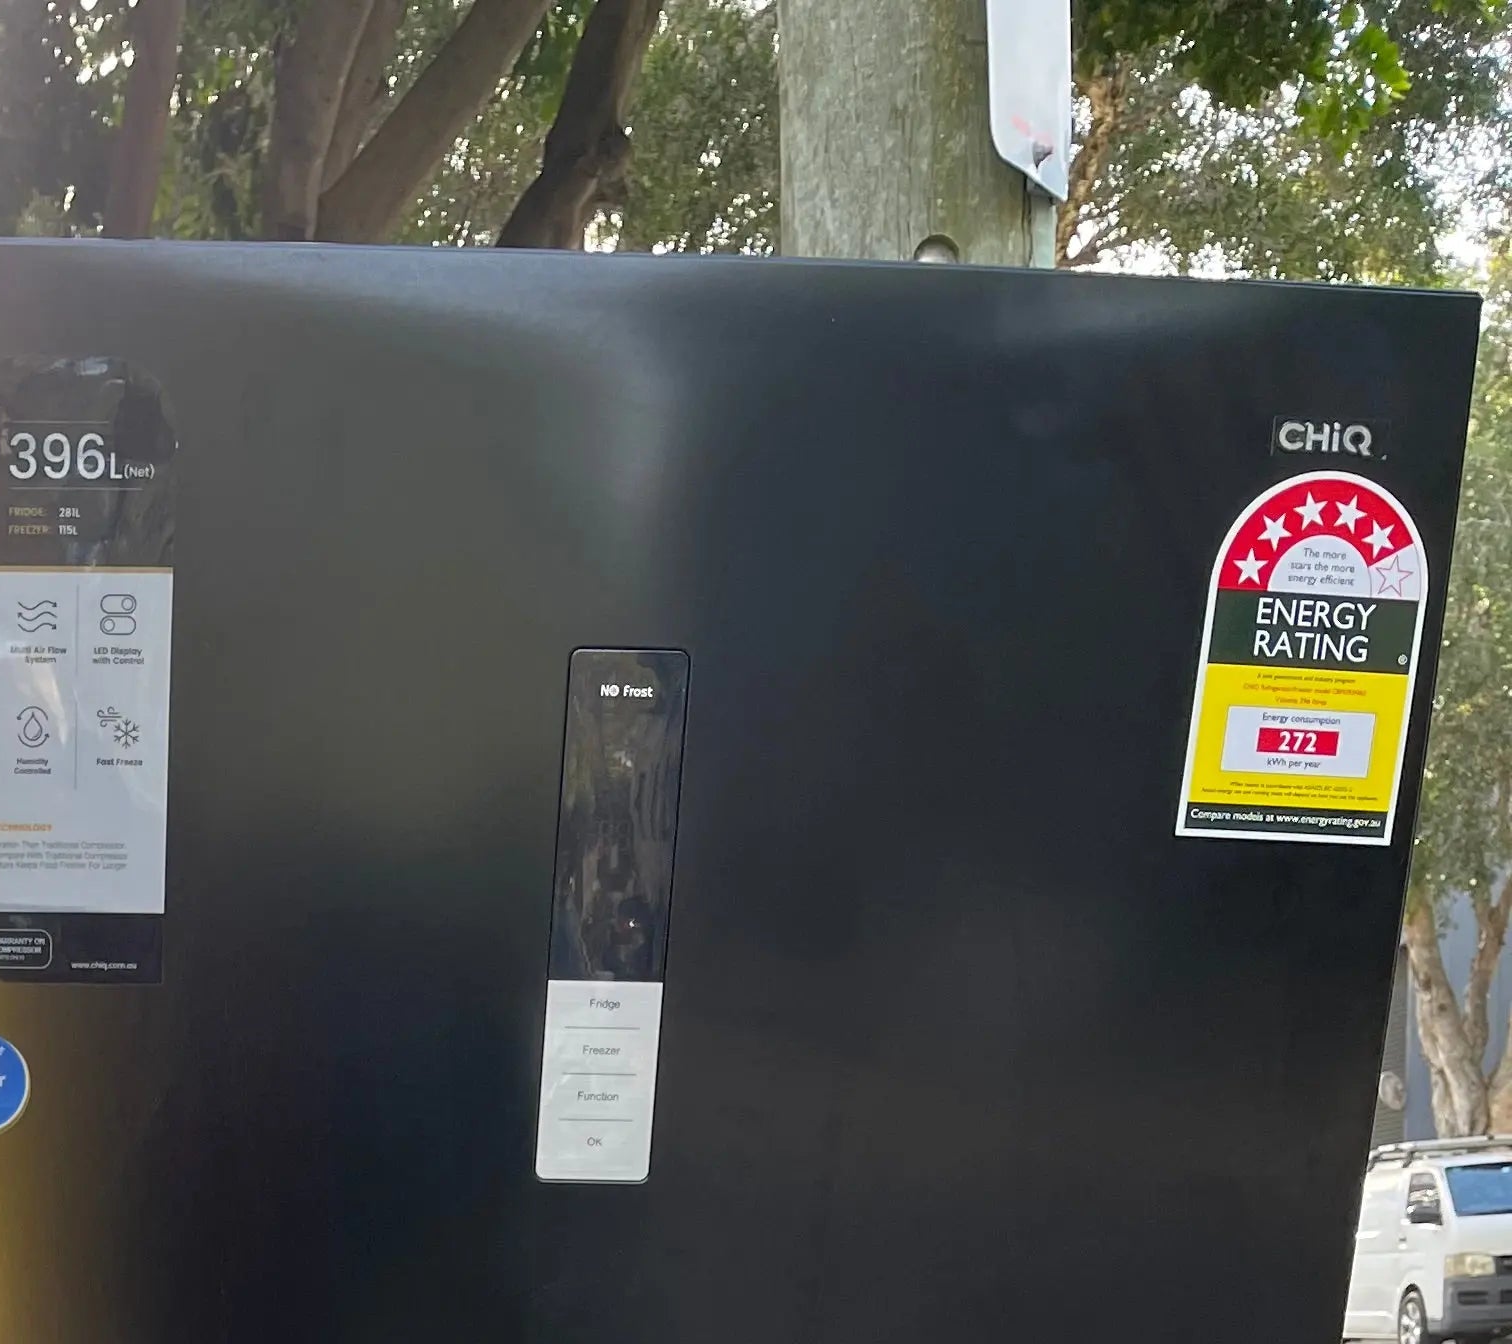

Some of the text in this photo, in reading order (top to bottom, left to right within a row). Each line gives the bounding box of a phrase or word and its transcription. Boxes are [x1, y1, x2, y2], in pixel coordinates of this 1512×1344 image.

[1278, 421, 1373, 457] CHiQ
[58, 507, 81, 518] 281L
[58, 525, 79, 535] 115L
[1303, 547, 1347, 560] The more
[1290, 561, 1355, 573] stars the more
[1288, 575, 1355, 586] energy efficient
[1255, 597, 1377, 631] ENERGY
[47, 646, 67, 655] Flow
[1253, 629, 1369, 663] RATING
[94, 647, 143, 657] LED Display
[113, 656, 145, 665] Control
[600, 684, 620, 697] NO
[1262, 712, 1341, 726] Energy consumption
[1278, 730, 1317, 753] 272
[1267, 758, 1321, 769] kWh per year
[1190, 808, 1382, 829] Compare models at www.energyrating.gov.au
[589, 999, 621, 1010] Fridge
[582, 1045, 621, 1056] Freezer
[577, 1091, 620, 1101] Function
[587, 1137, 602, 1147] OK
